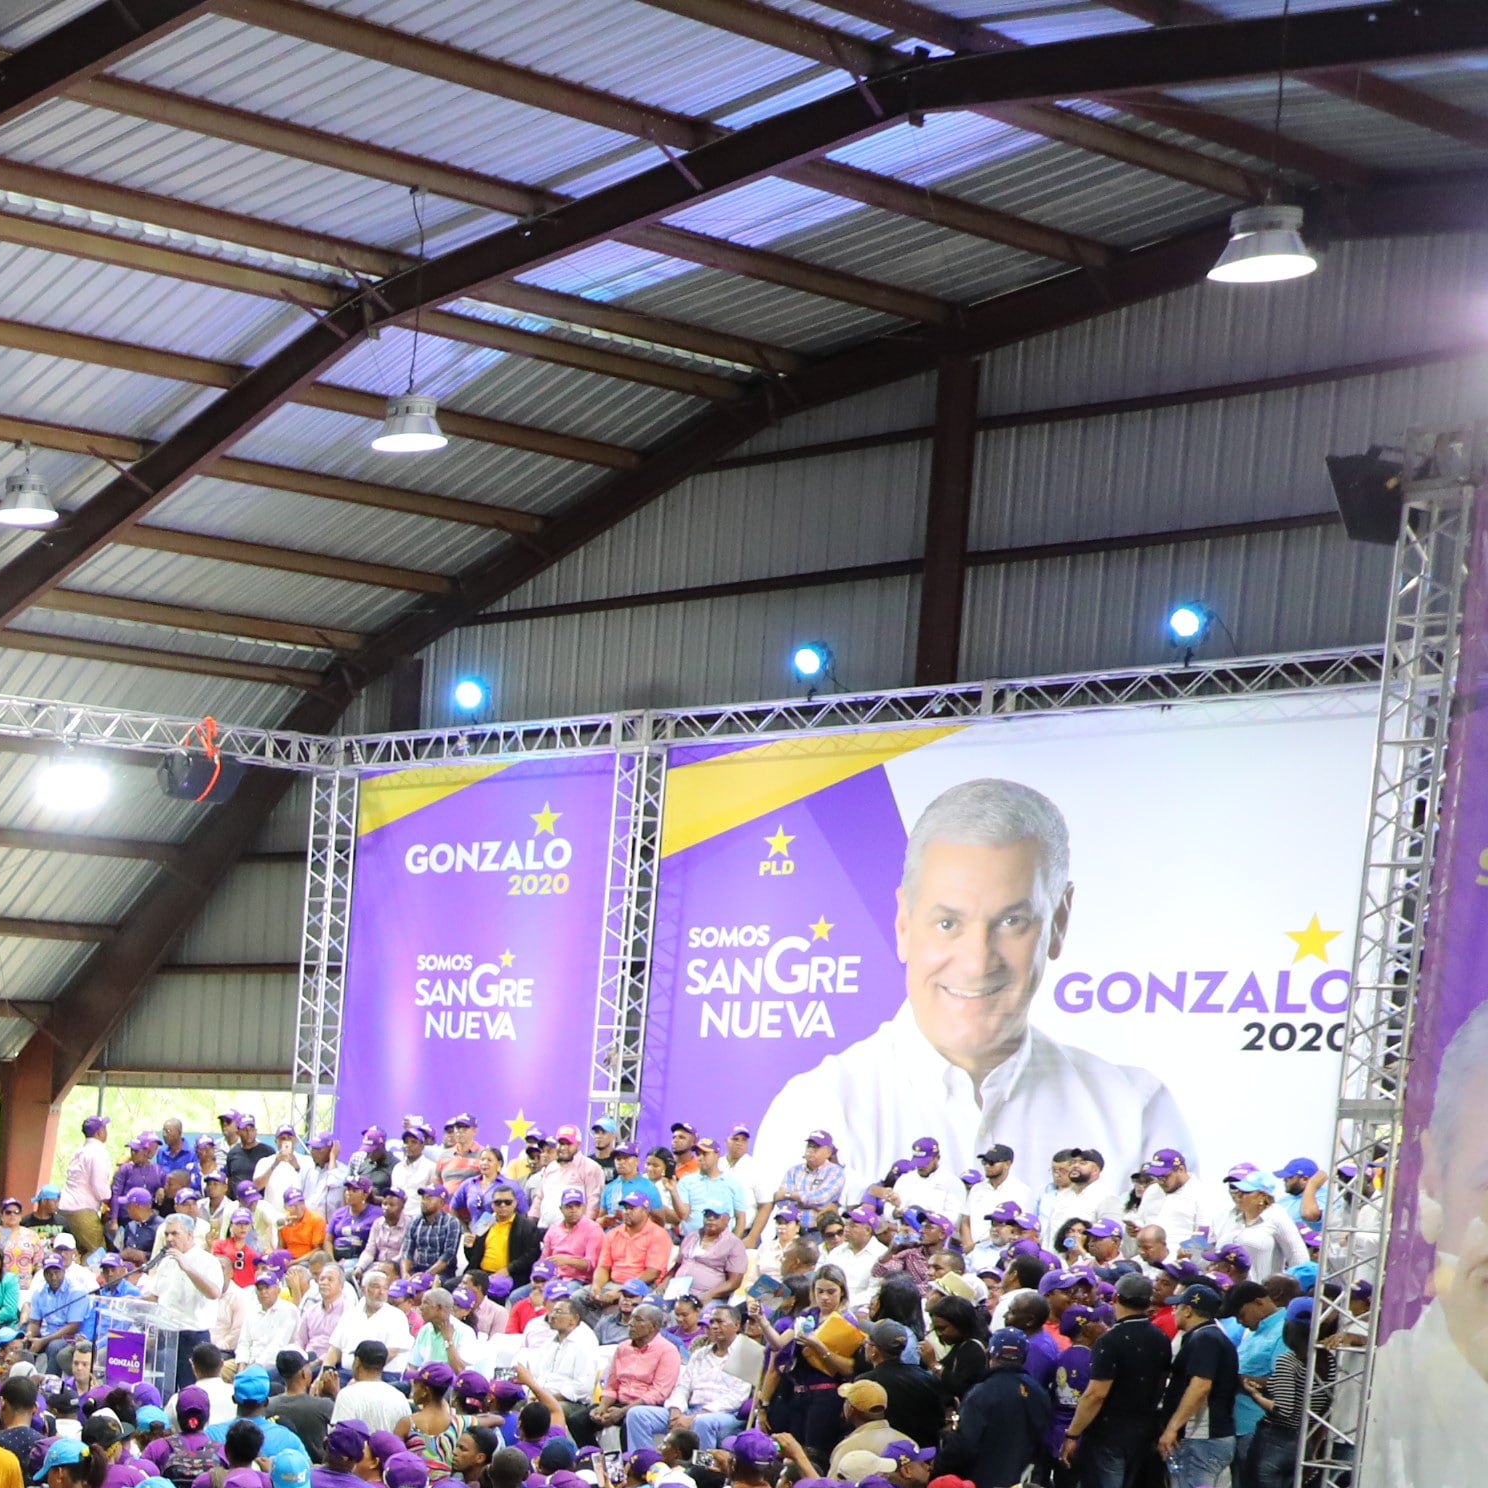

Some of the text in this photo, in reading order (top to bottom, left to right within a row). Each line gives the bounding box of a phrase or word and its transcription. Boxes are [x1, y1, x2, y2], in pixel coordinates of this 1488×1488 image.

[404, 837, 572, 875] GONZALO
[759, 860, 795, 876] PLD
[508, 874, 570, 896] 2020
[688, 924, 770, 948] SOMOS
[417, 953, 473, 972] SOMOS
[685, 936, 861, 996] SANGRE
[415, 963, 535, 1008] SANGRE
[1052, 969, 1353, 1015] GONZALO
[424, 1011, 517, 1041] NUEVA
[699, 1001, 836, 1039] NUEVA
[1240, 1021, 1347, 1052] 2020
[108, 1357, 140, 1368] GONZALO
